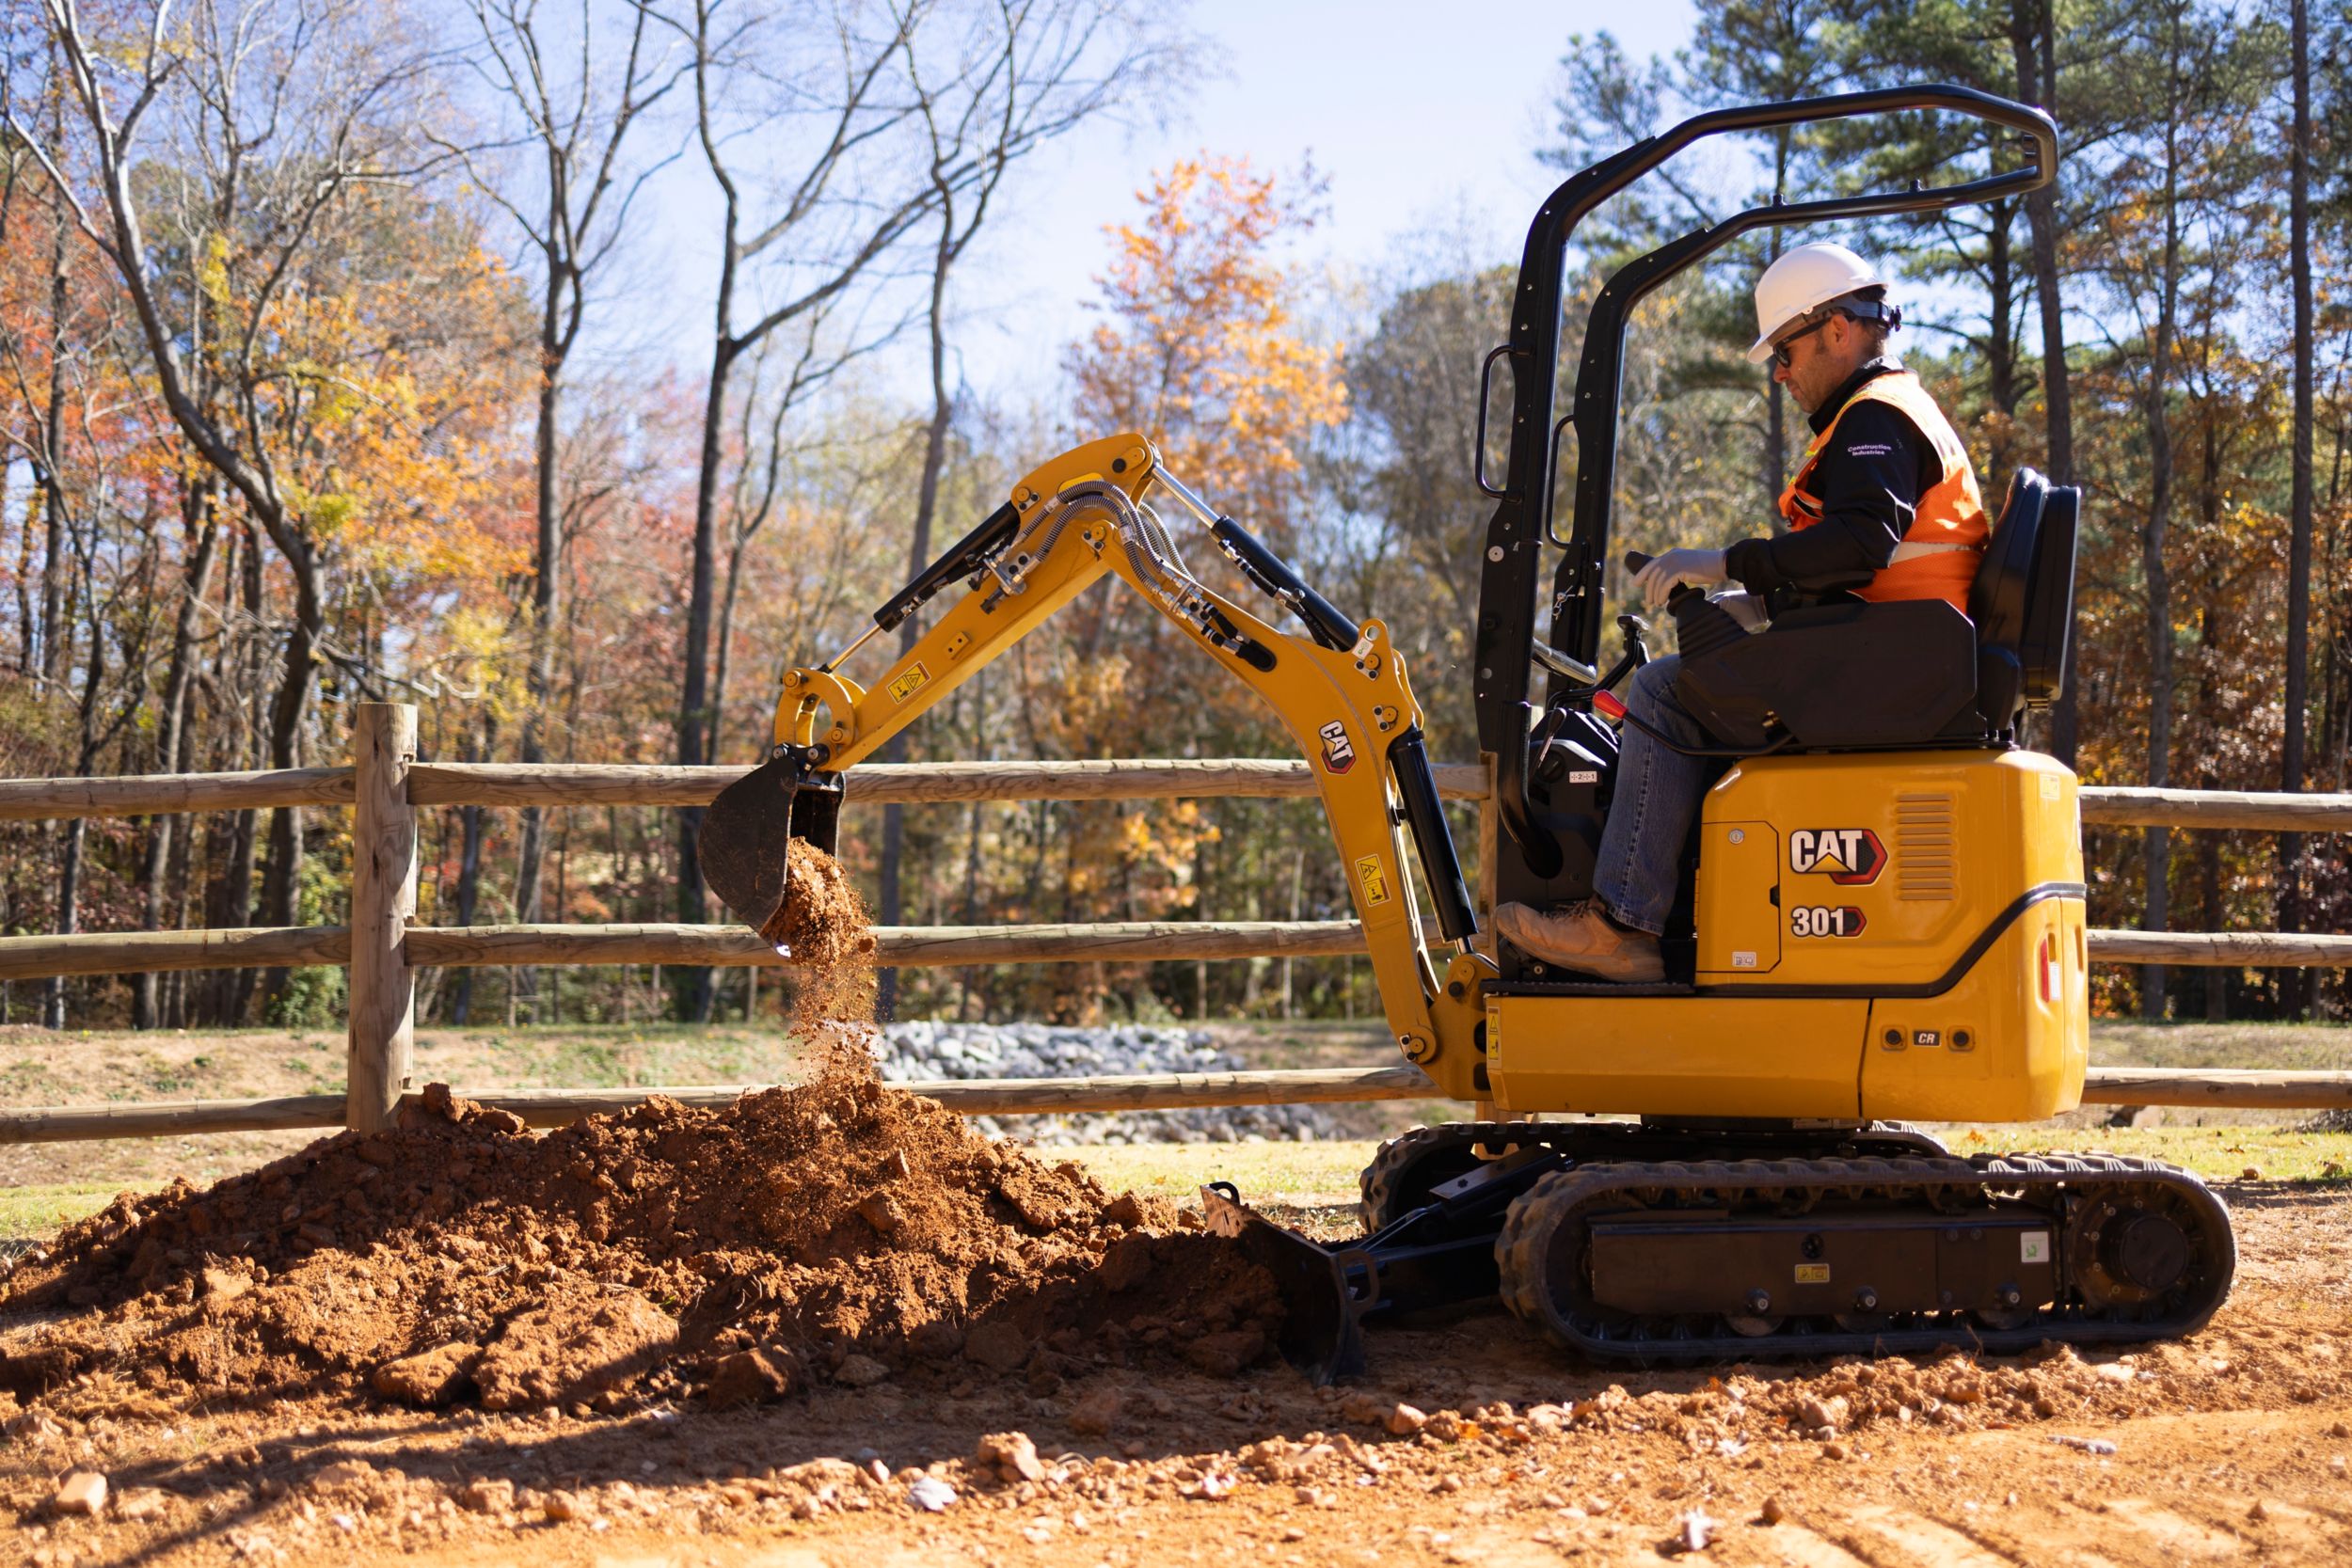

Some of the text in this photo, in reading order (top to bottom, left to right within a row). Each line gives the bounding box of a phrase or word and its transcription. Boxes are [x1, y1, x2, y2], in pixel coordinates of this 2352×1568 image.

[1847, 444, 1892, 452] Construction
[1320, 721, 1354, 762] CAT
[1790, 830, 1863, 873] CAT
[1792, 907, 1844, 936] 301
[1918, 1033, 1935, 1044] CR
